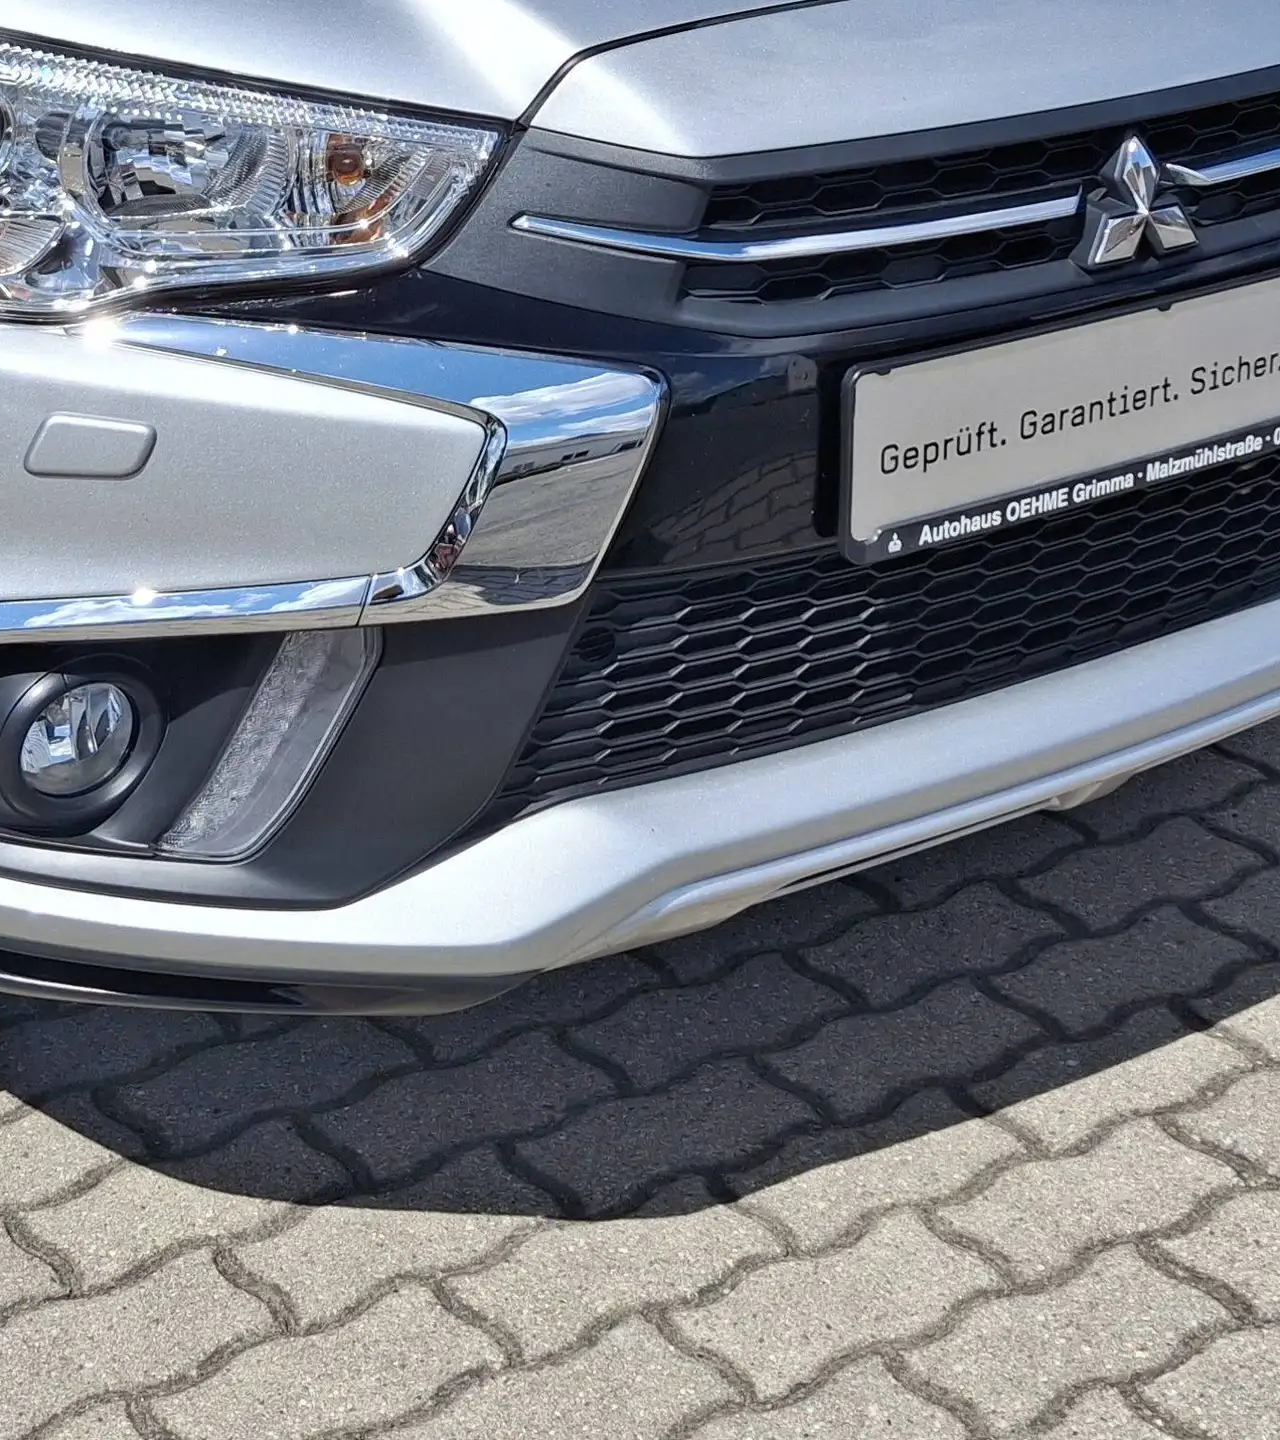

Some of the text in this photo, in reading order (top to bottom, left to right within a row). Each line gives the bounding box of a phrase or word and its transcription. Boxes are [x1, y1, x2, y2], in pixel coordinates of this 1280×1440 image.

[880, 421, 1007, 475] Geprüft.
[1019, 378, 1180, 440] Garantiert.
[919, 510, 1002, 546] Autohaus
[1006, 486, 1069, 523] OEHME
[1072, 470, 1135, 503] Grimma
[1146, 434, 1263, 482] Malzmühlstraße
